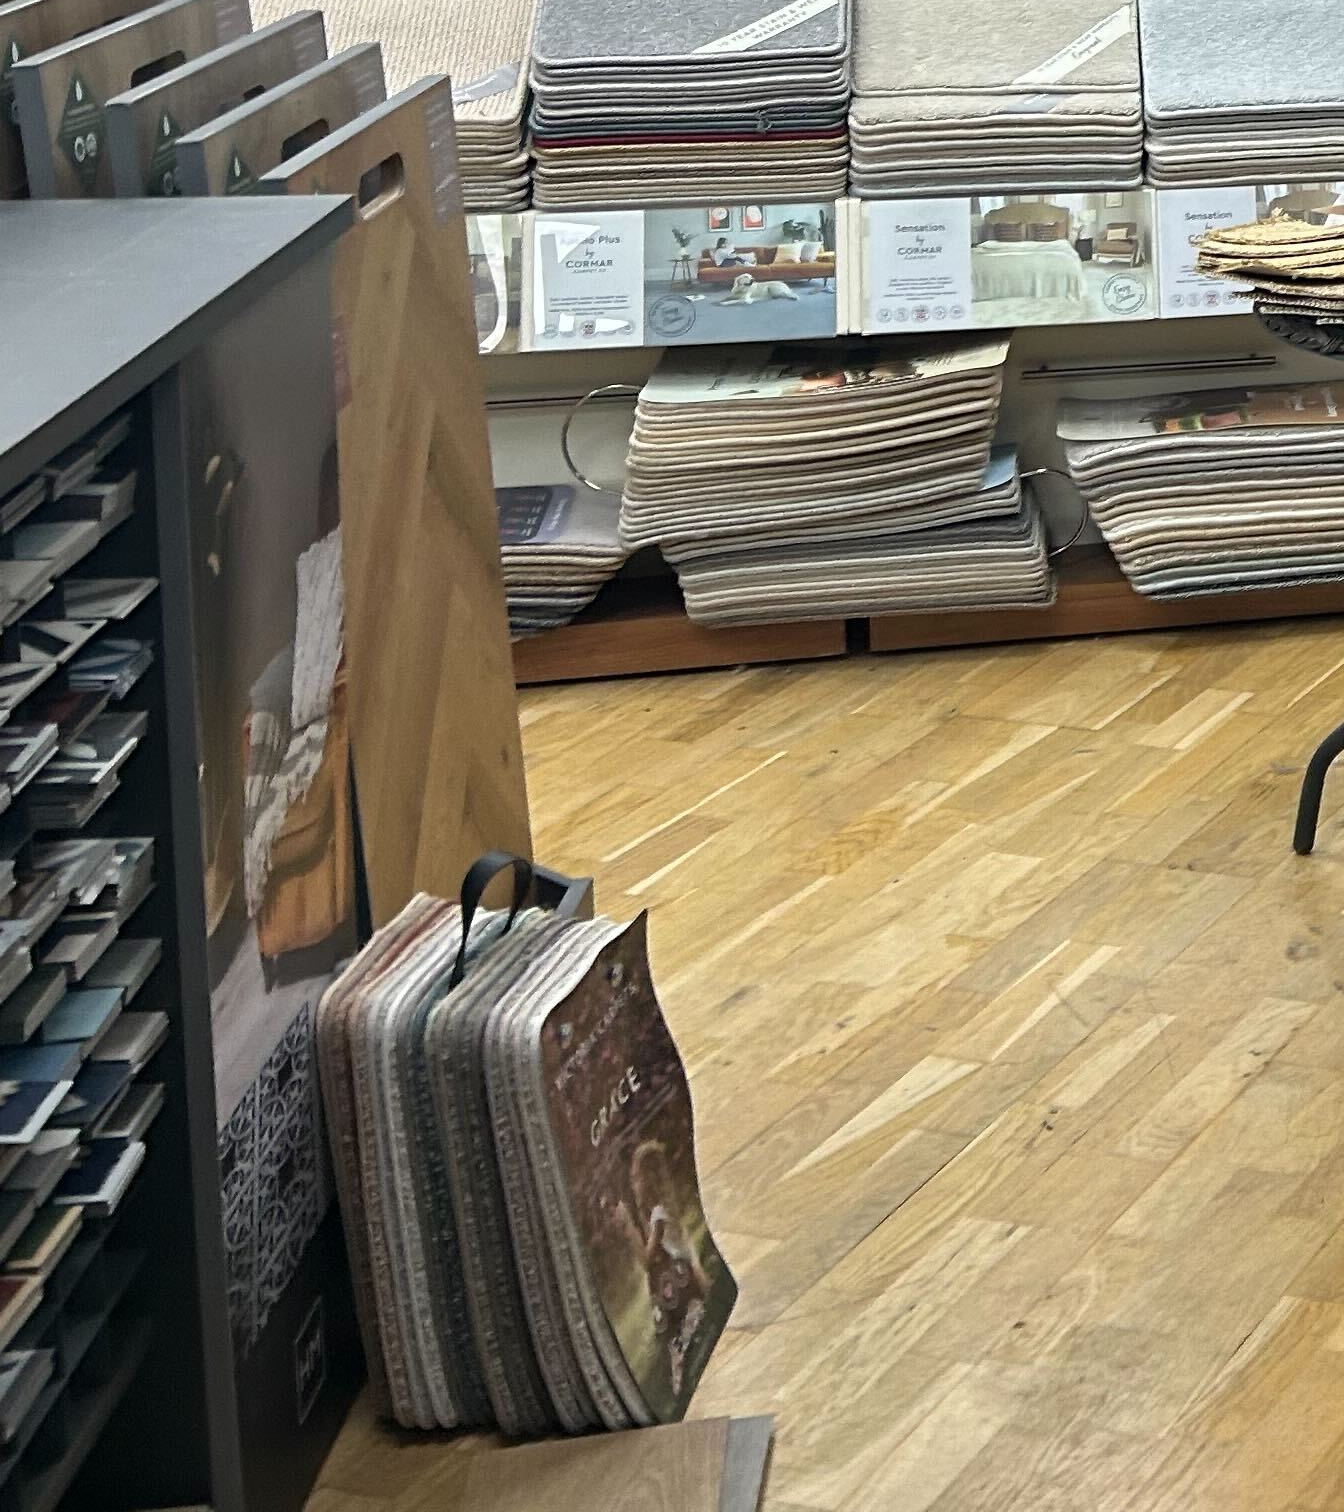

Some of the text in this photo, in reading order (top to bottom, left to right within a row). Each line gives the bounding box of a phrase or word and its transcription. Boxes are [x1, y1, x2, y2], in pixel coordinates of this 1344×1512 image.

[1184, 211, 1233, 220] Sensation
[895, 224, 946, 233] Sensation
[897, 246, 943, 256] CORMAR
[565, 259, 613, 269] CORMAR
